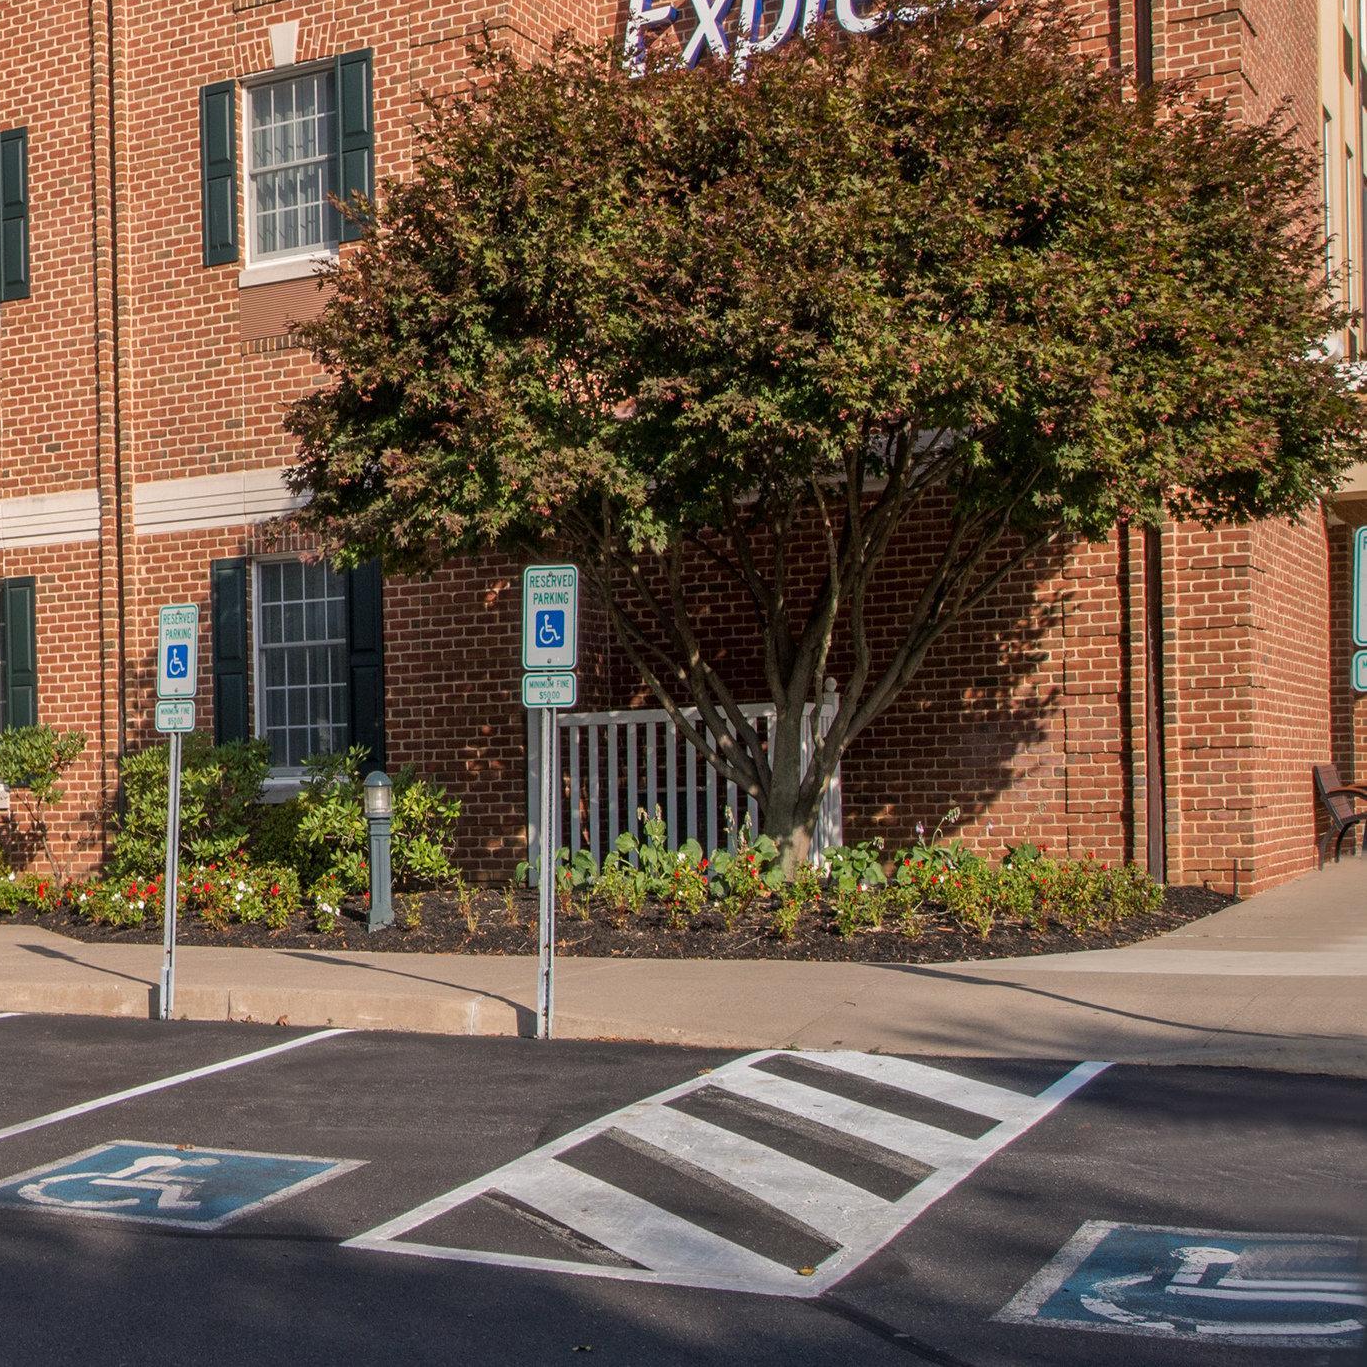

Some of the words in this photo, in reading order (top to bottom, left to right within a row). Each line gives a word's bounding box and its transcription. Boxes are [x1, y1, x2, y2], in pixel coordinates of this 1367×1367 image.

[529, 573, 574, 589] RESERVED
[532, 591, 569, 606] PARKING
[163, 612, 195, 625] RESERVED
[165, 627, 192, 640] PARKING
[556, 679, 569, 688] FINE
